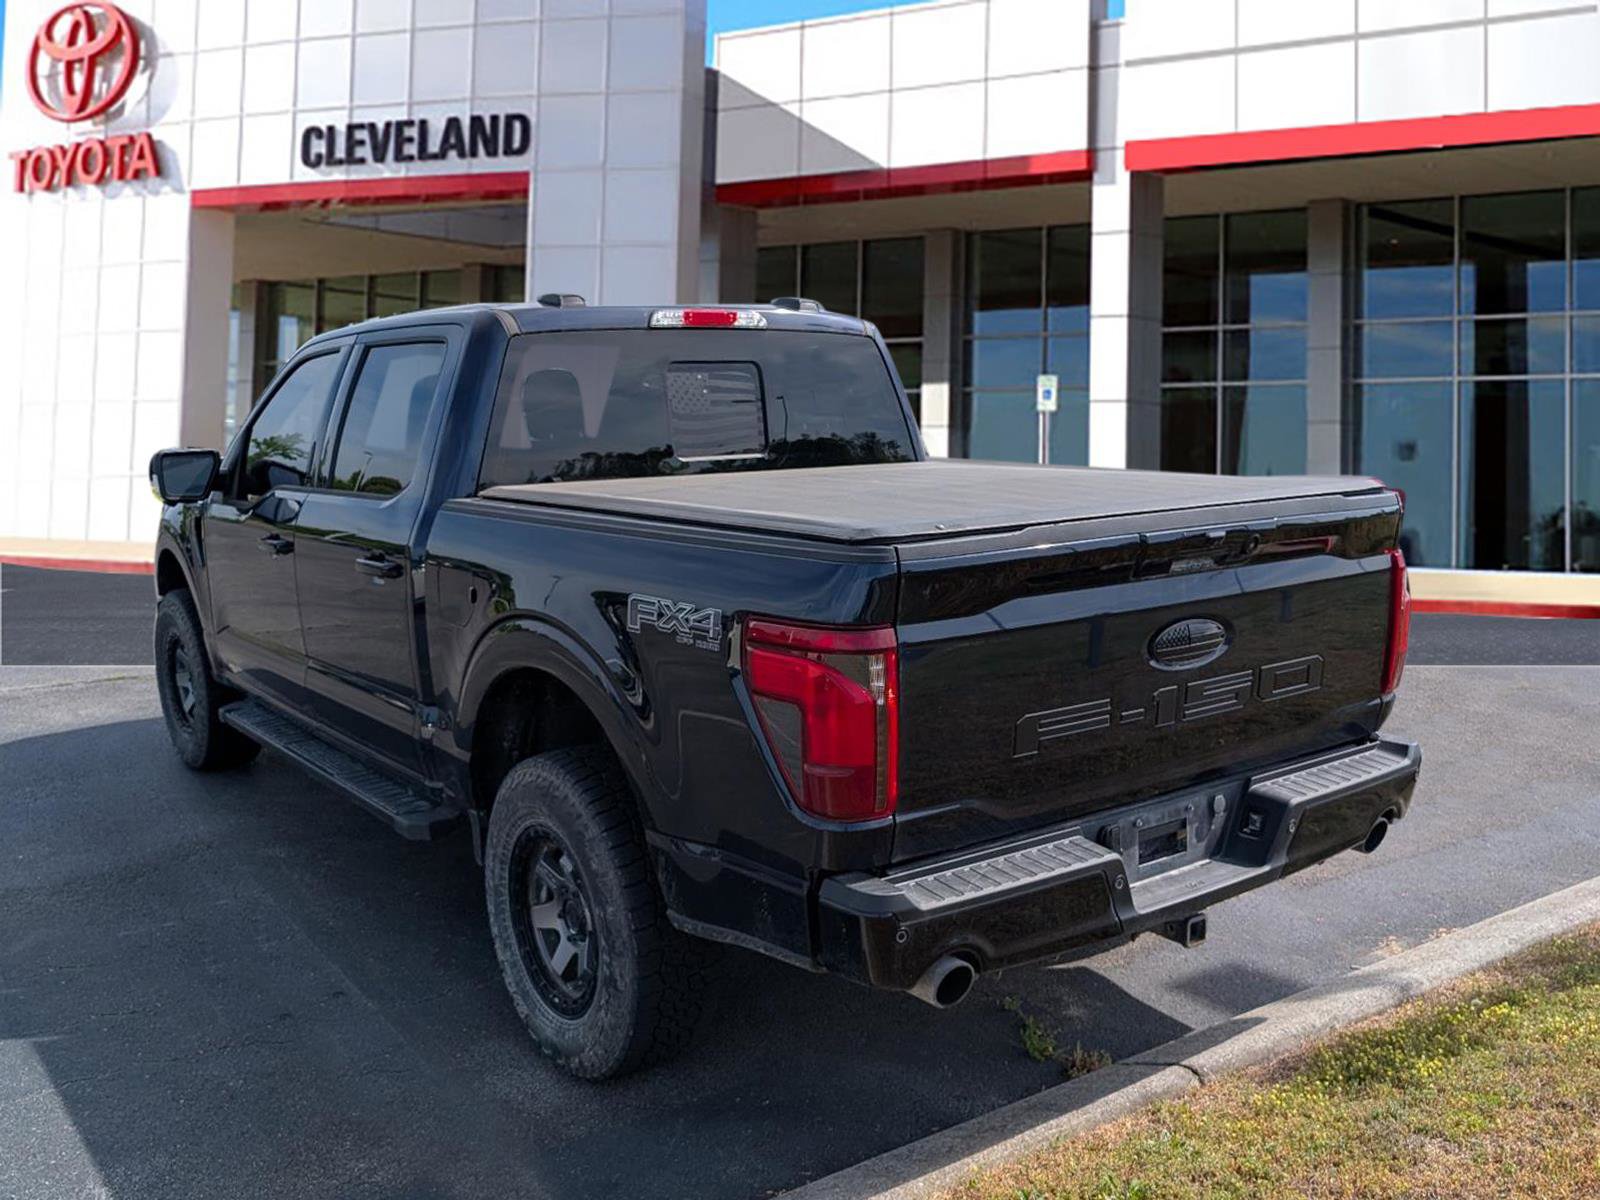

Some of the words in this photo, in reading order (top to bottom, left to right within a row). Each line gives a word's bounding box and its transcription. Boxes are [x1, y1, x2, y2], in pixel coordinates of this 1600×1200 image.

[9, 132, 160, 193] TOYOTA
[301, 113, 531, 168] CLEVELAND
[626, 592, 722, 643] FX4
[1012, 654, 1325, 759] F-150
